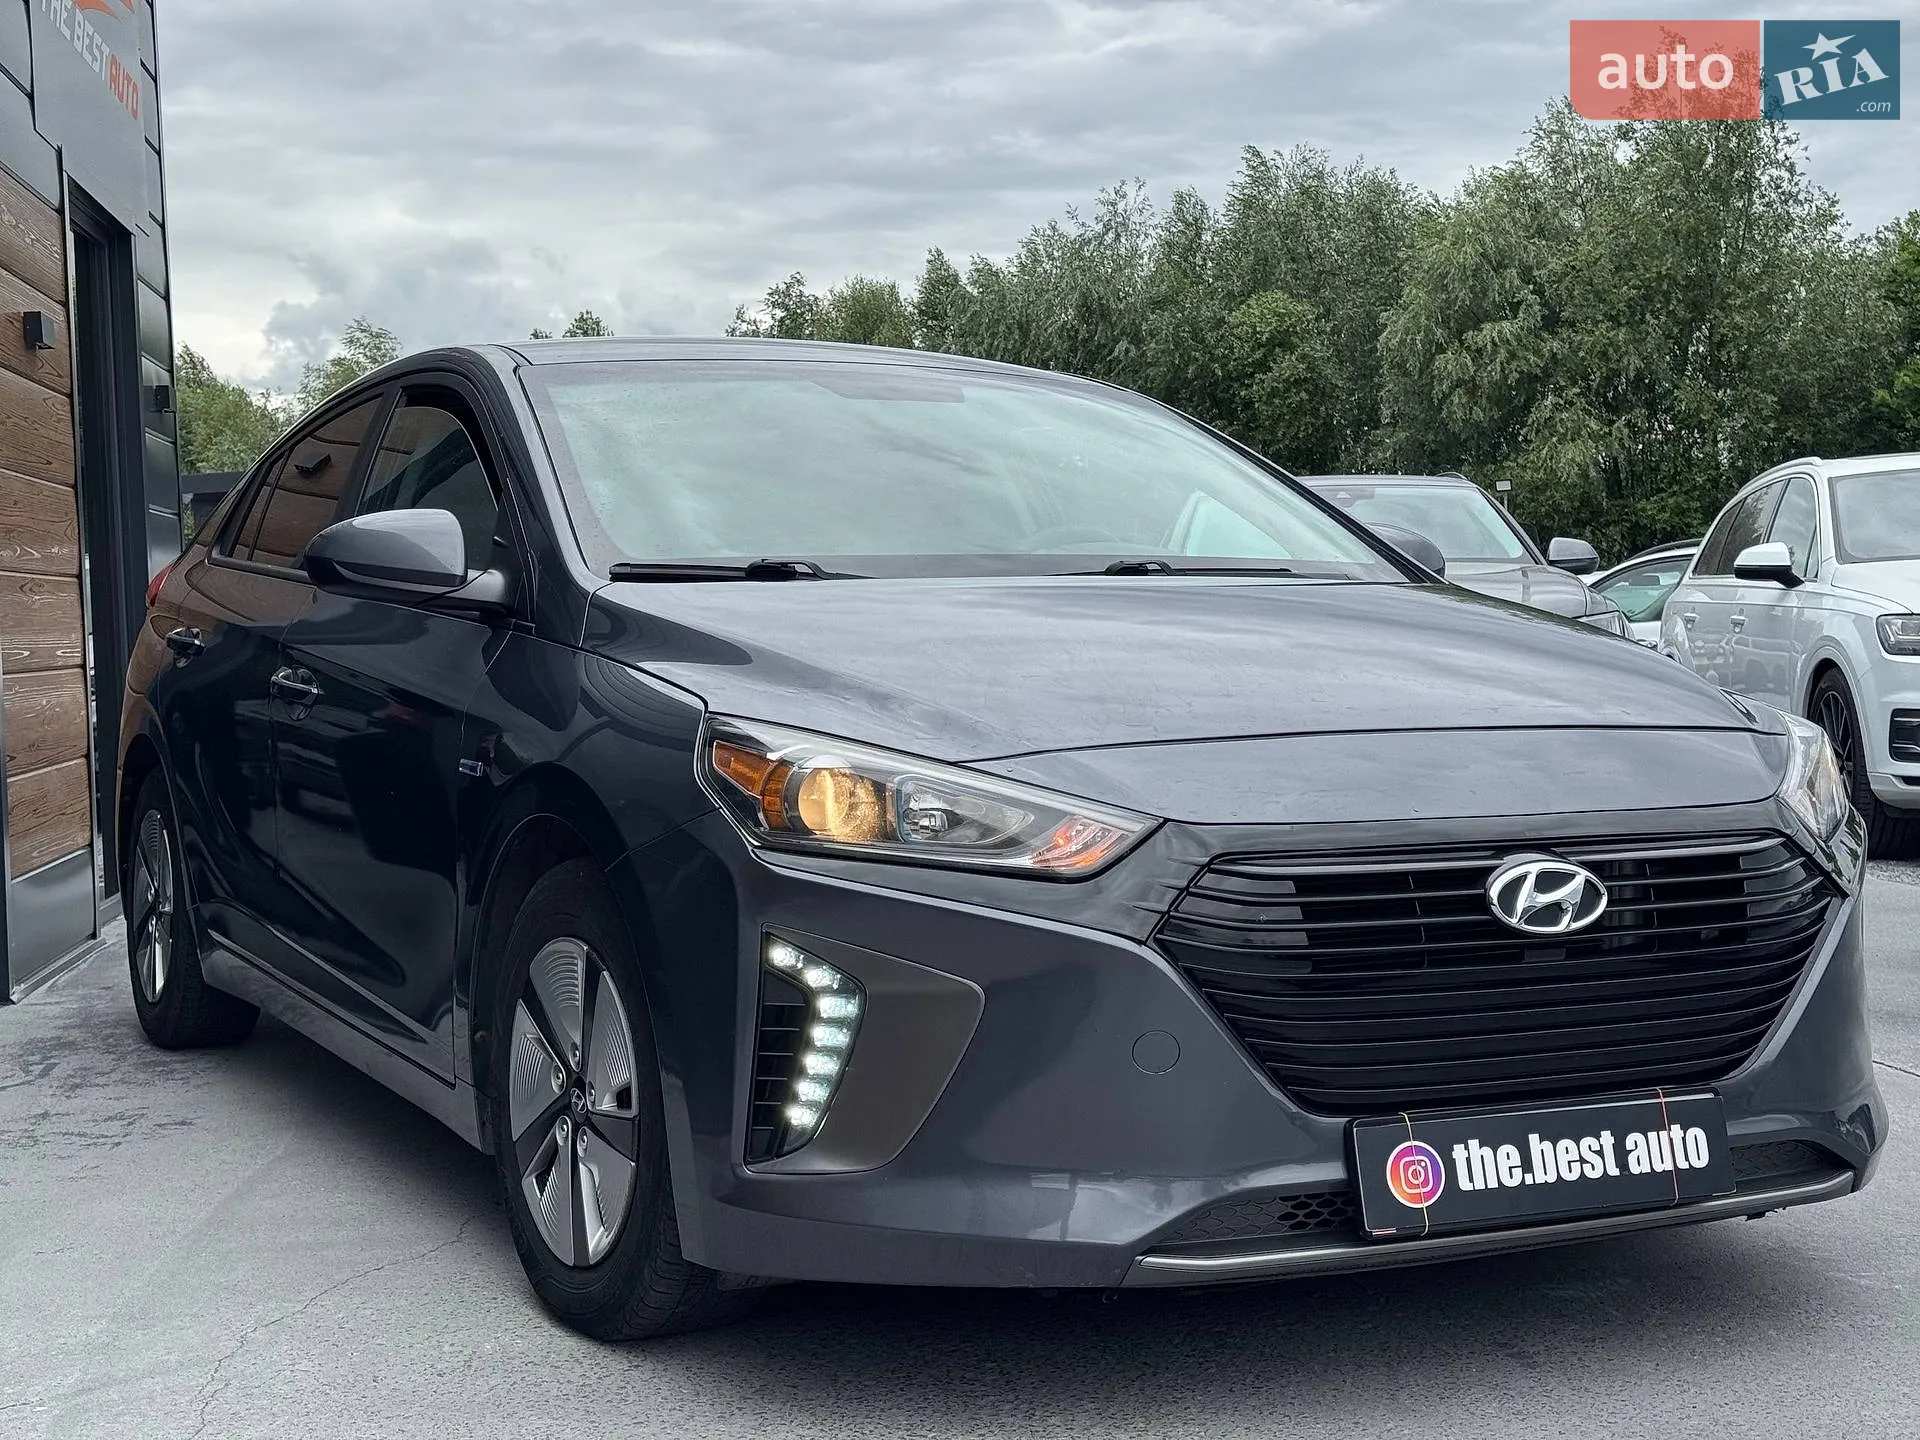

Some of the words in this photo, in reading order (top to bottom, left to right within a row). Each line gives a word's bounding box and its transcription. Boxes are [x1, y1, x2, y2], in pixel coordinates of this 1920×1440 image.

[74, 9, 110, 81] BEST
[109, 54, 139, 121] AUTO
[1627, 1124, 1710, 1174] auto
